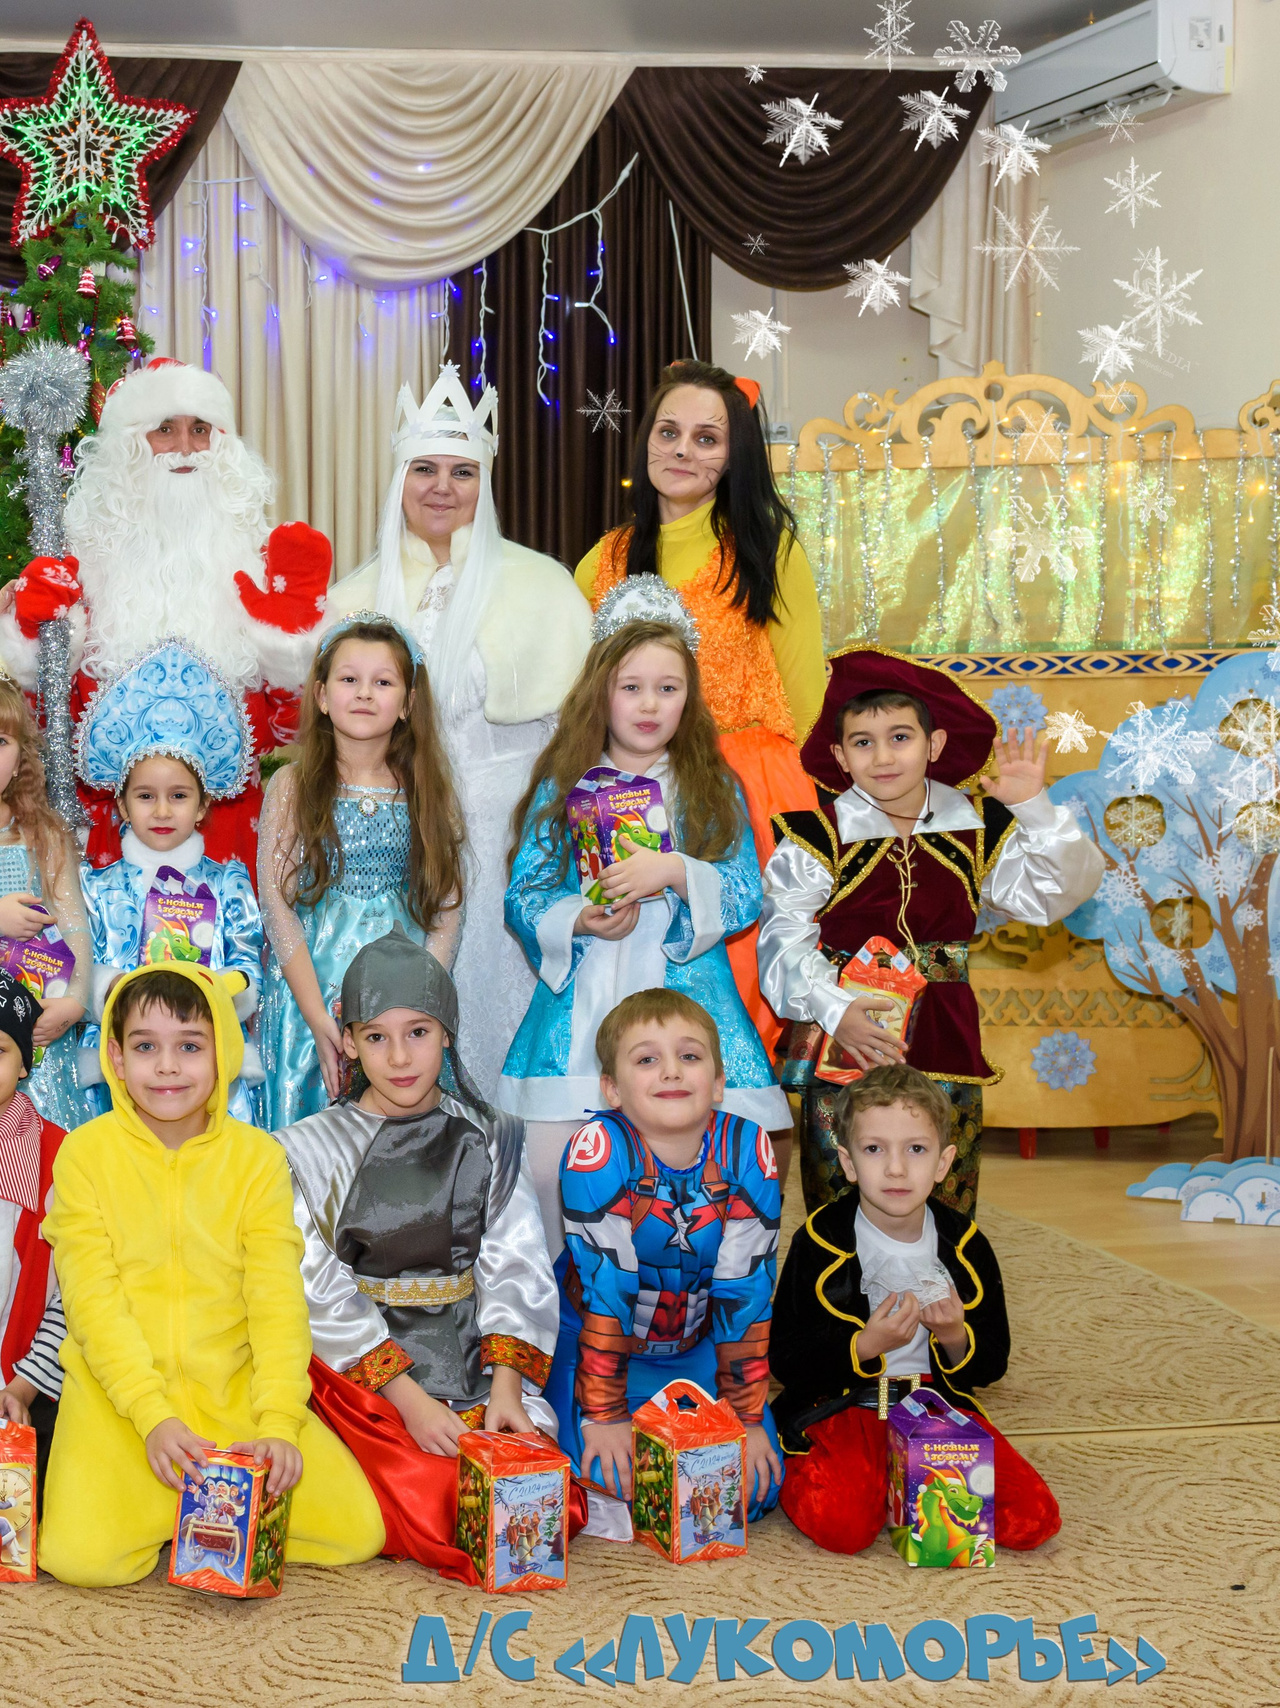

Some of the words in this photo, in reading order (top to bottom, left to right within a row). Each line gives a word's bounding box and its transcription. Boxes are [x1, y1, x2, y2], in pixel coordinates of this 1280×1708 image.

[615, 788, 651, 801] НОВЫМ
[166, 898, 204, 910] НОВЫМ
[30, 950, 64, 967] НОВЫМ
[923, 1443, 931, 1451] С
[933, 1443, 979, 1451] НОВЫМ
[699, 1454, 720, 1470] 2024
[517, 1483, 541, 1500] 2024
